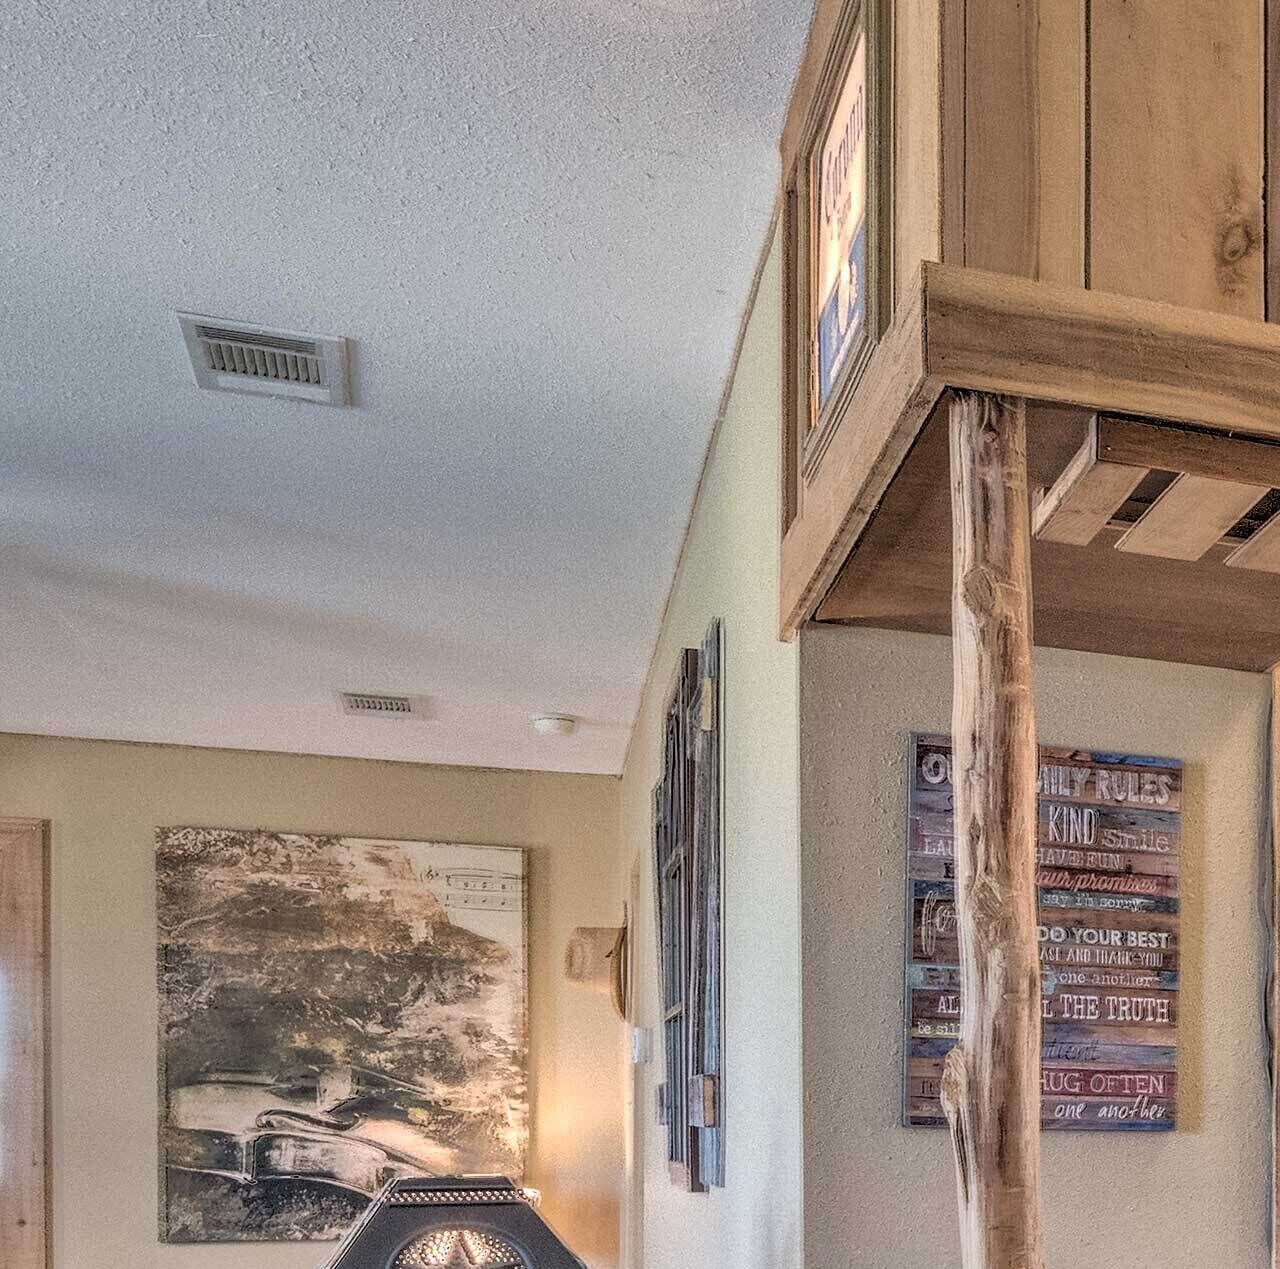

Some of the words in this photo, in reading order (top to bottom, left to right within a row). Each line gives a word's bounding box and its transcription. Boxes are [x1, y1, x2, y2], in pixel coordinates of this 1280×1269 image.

[1096, 769, 1173, 805] RULES
[1049, 805, 1098, 846] KIND
[1036, 847, 1083, 867] HAVE
[1037, 925, 1066, 943] DO
[1072, 927, 1123, 947] YOUR
[1127, 930, 1170, 949] BEST
[1066, 948, 1092, 963] AND
[1058, 972, 1086, 985] one
[1091, 972, 1153, 988] another
[1060, 994, 1099, 1020] THE
[1105, 995, 1171, 1023] TRUTH
[1090, 1073, 1166, 1094] OFTEN
[1055, 1101, 1087, 1119] one
[1098, 1095, 1166, 1121] another
